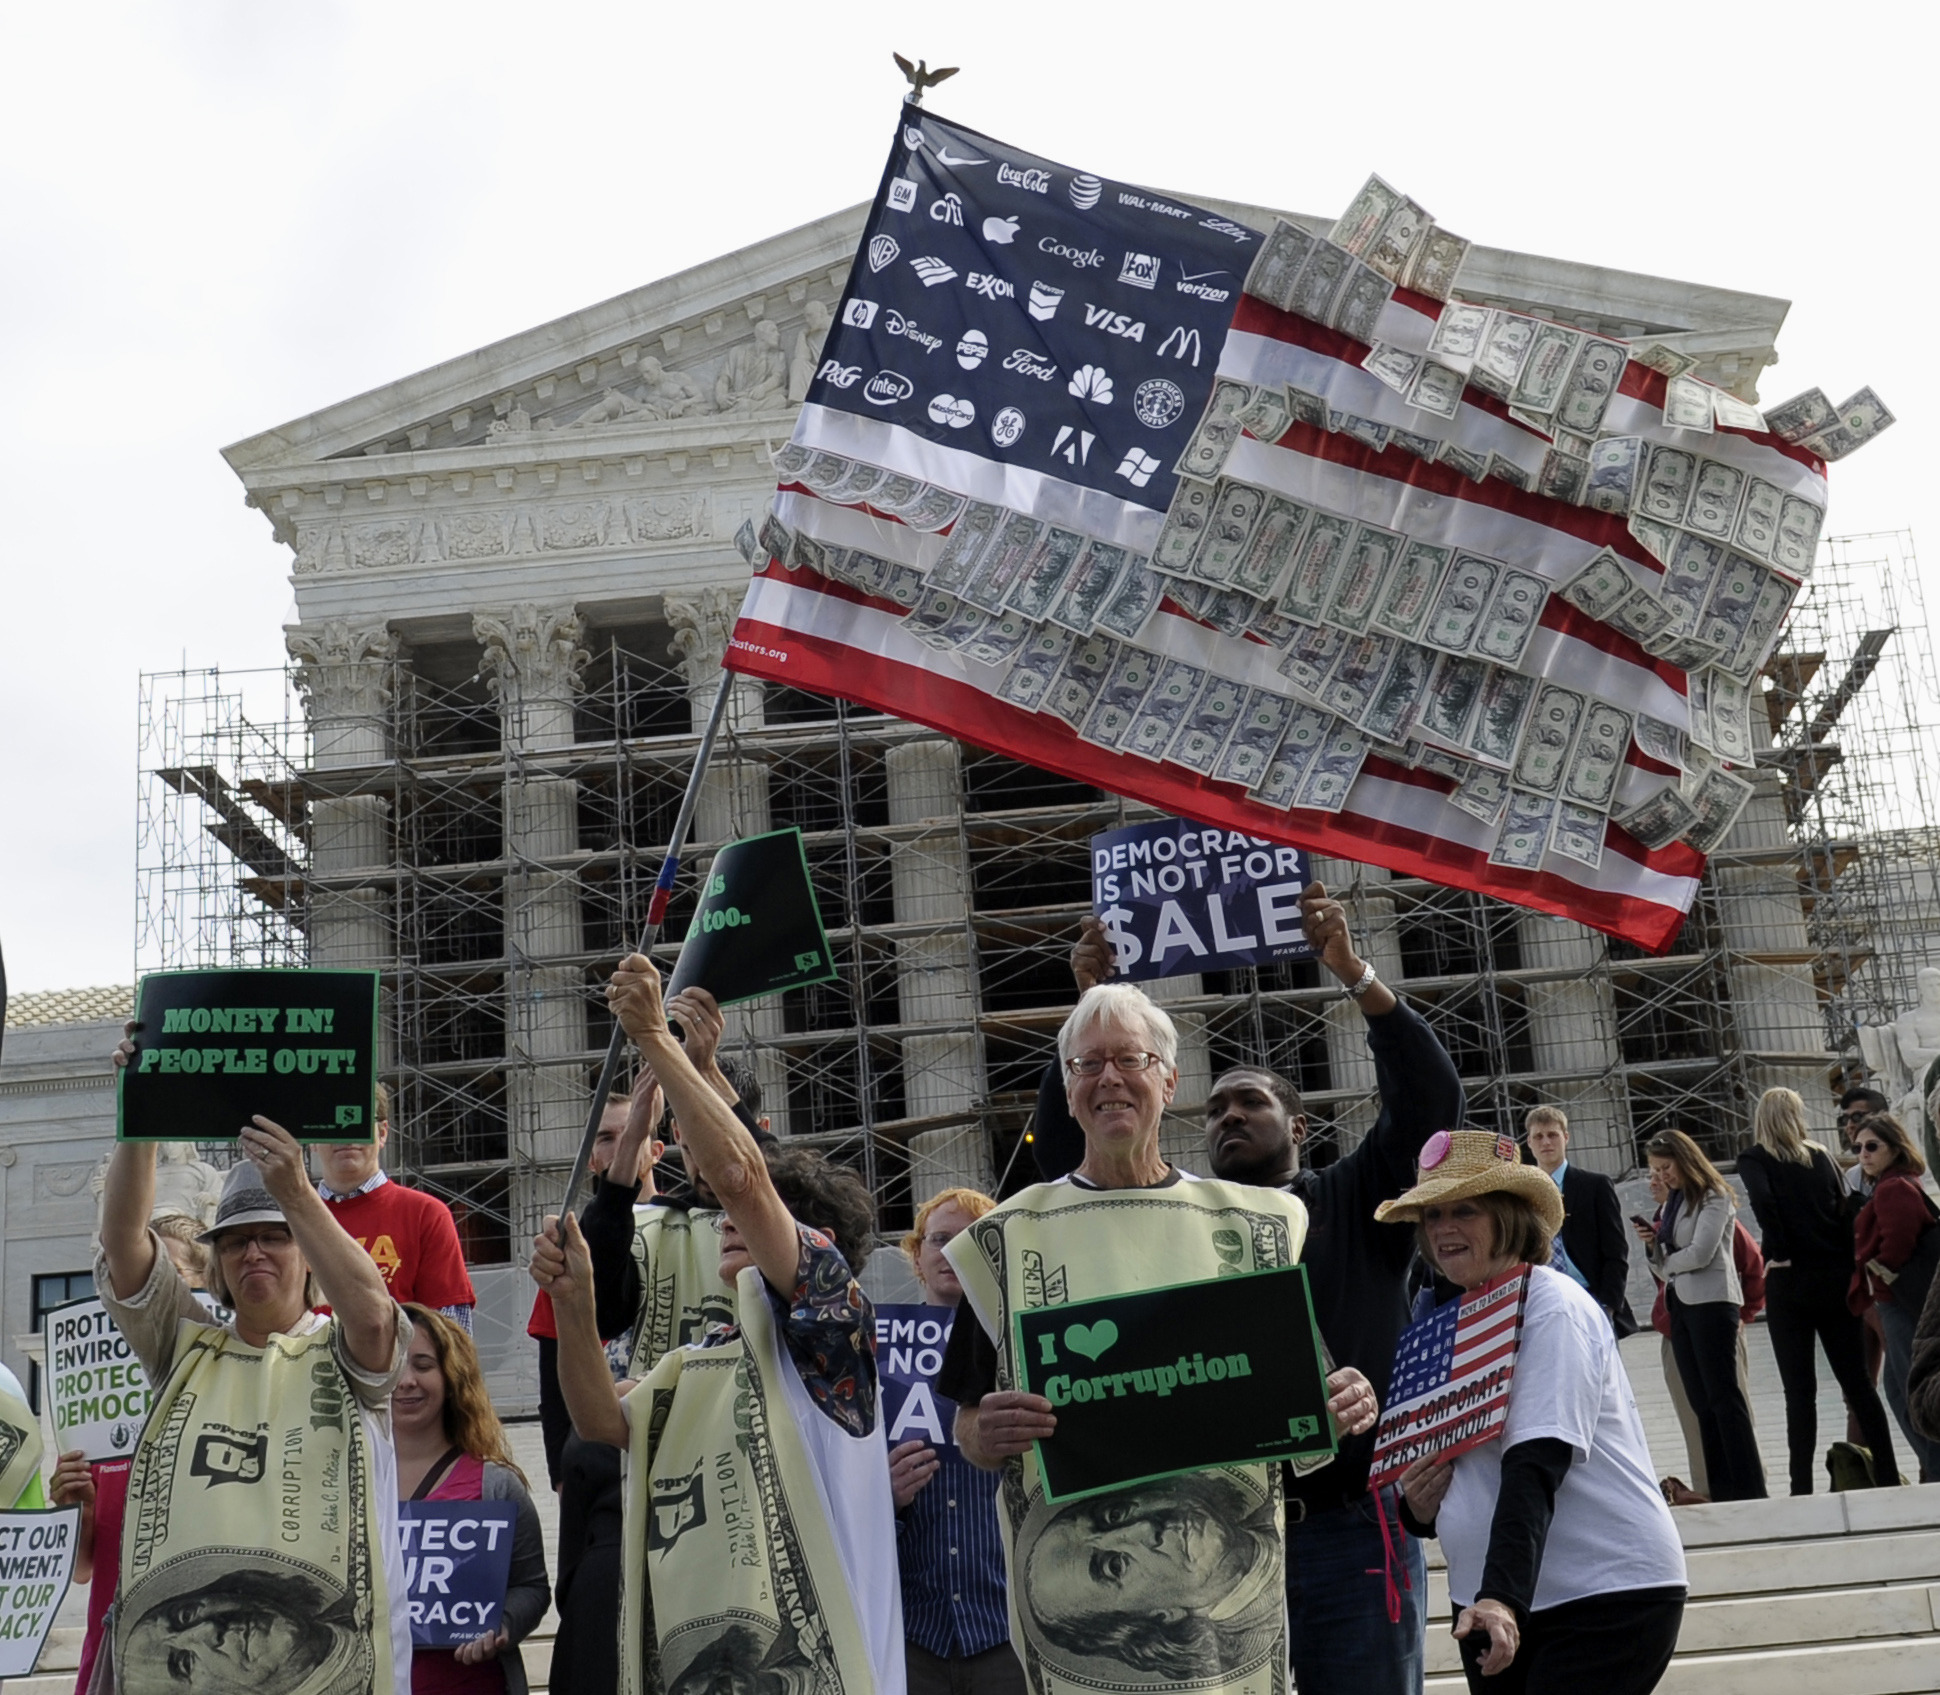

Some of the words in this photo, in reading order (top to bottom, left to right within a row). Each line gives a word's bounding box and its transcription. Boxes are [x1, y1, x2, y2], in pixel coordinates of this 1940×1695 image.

[1038, 236, 1105, 268] Google
[965, 271, 1015, 301] EXXON
[1176, 281, 1229, 302] verizon
[885, 308, 943, 354] Disney
[1084, 302, 1146, 342] VISA
[955, 341, 989, 359] PEPSI
[1002, 348, 1057, 382] Ford
[816, 359, 862, 388] P&G
[1138, 382, 1182, 408] STARBUCKS
[1138, 407, 1170, 425] COFFEE
[1095, 829, 1272, 874] DEMOCRA
[1096, 874, 1121, 904] IS
[1131, 861, 1207, 898] NOT
[1221, 848, 1301, 885] FOR
[702, 907, 751, 933] too.
[1100, 881, 1307, 975] $ALE
[162, 1008, 279, 1033] MONEY
[285, 1008, 334, 1033] IN!
[138, 1049, 267, 1073] PEOPLE
[273, 1049, 356, 1074] OUT!
[55, 1337, 132, 1372] ENVIRO
[888, 1347, 943, 1376] NO
[1037, 1333, 1058, 1365] I
[56, 1362, 143, 1401] PROTEC
[1044, 1352, 1252, 1407] Corruption
[1378, 1410, 1410, 1445] END
[1416, 1365, 1507, 1429] CORPORATE
[1380, 1404, 1493, 1473] PERSONHOOD!
[753, 1436, 792, 1571] HUNDRED
[28, 1524, 68, 1550] OUR
[12, 1583, 56, 1610] OUR
[779, 1572, 807, 1629] ONE
